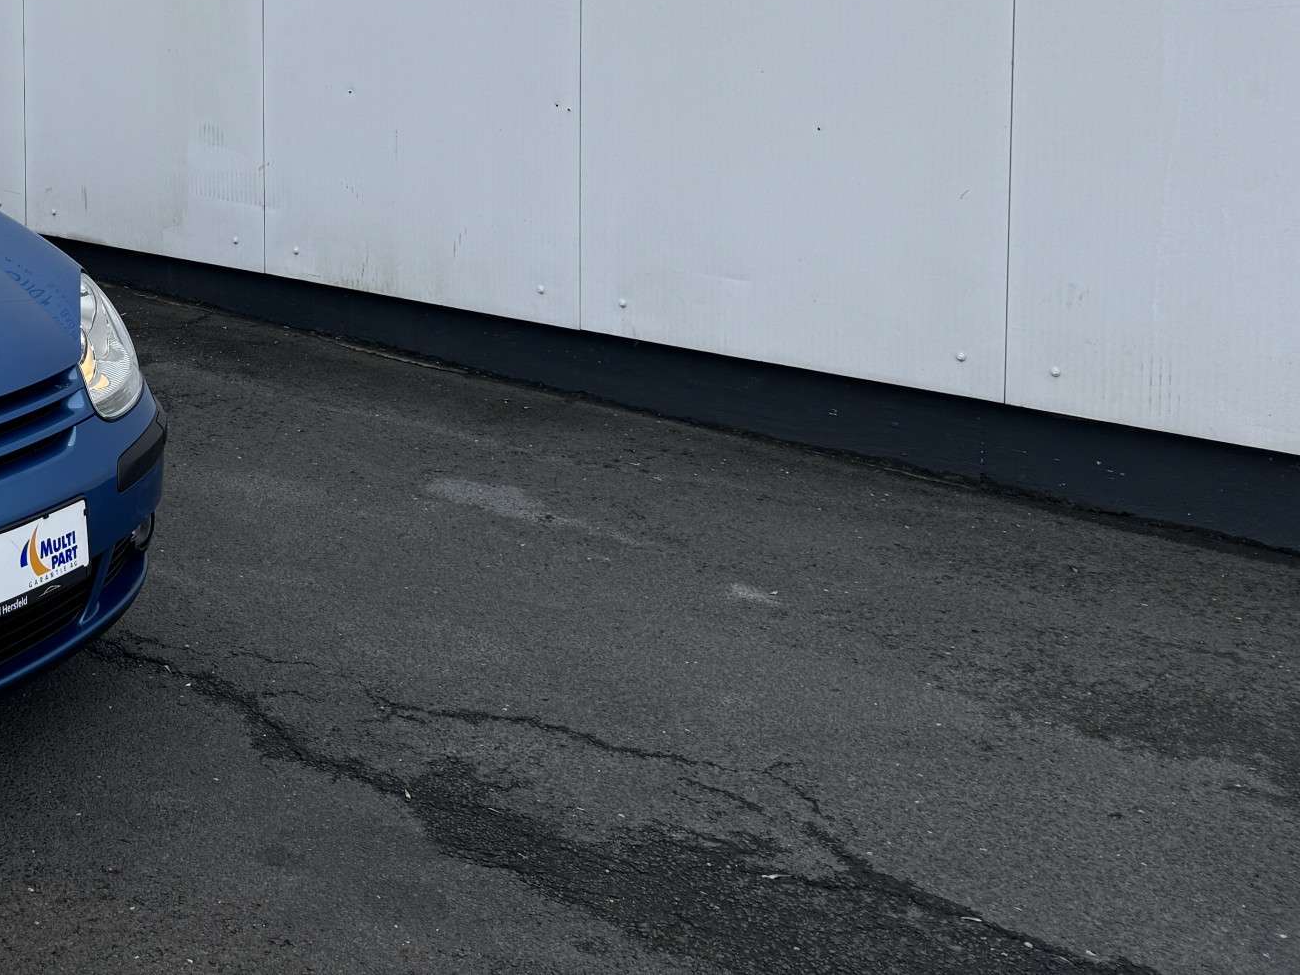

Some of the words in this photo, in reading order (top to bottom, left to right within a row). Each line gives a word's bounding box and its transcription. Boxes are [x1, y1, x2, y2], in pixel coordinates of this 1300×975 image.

[40, 530, 76, 559] MULTI
[51, 544, 78, 570] PART
[2, 595, 28, 615] Hersfeld
